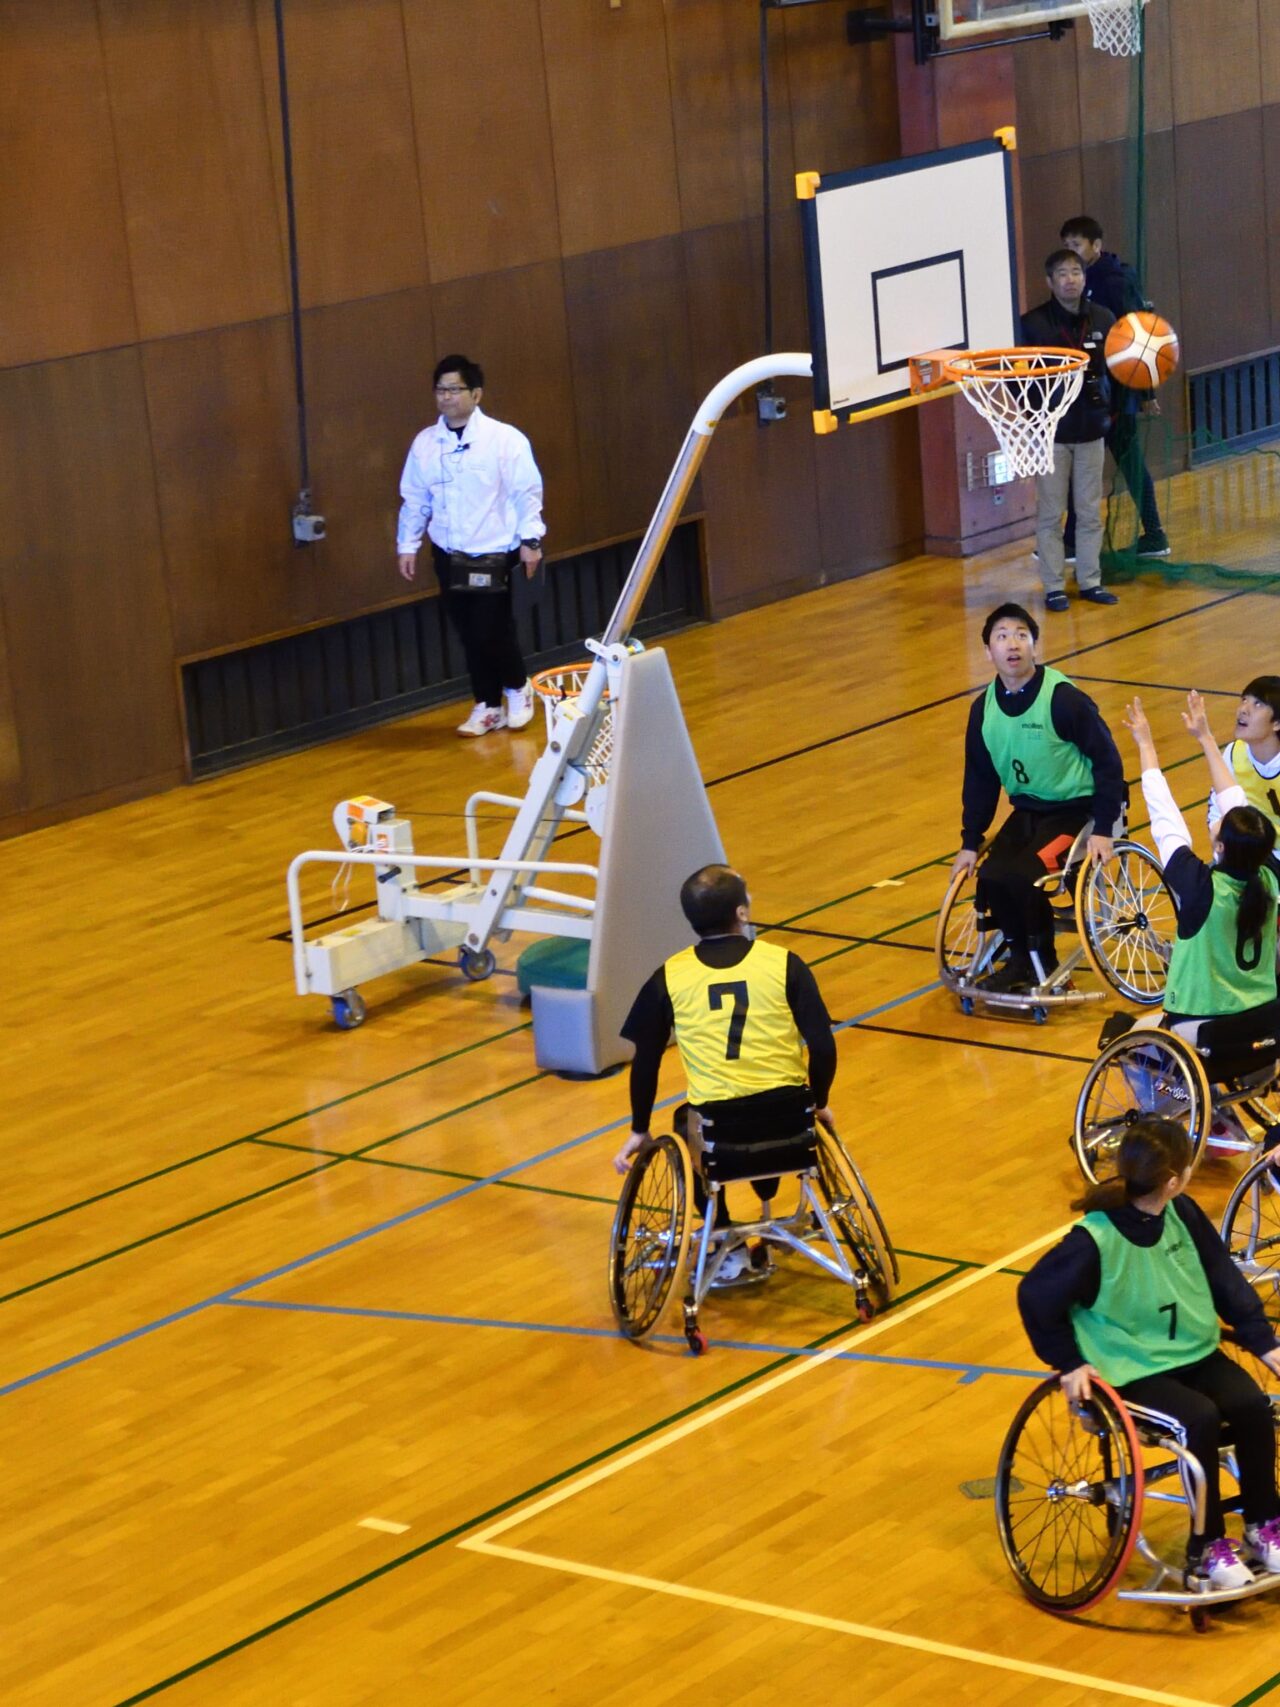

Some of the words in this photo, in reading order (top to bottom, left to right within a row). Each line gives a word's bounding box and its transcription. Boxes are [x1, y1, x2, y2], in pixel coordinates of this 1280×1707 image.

[1012, 759, 1029, 784] 8
[708, 980, 750, 1061] 7
[1158, 1302, 1177, 1341] 7
